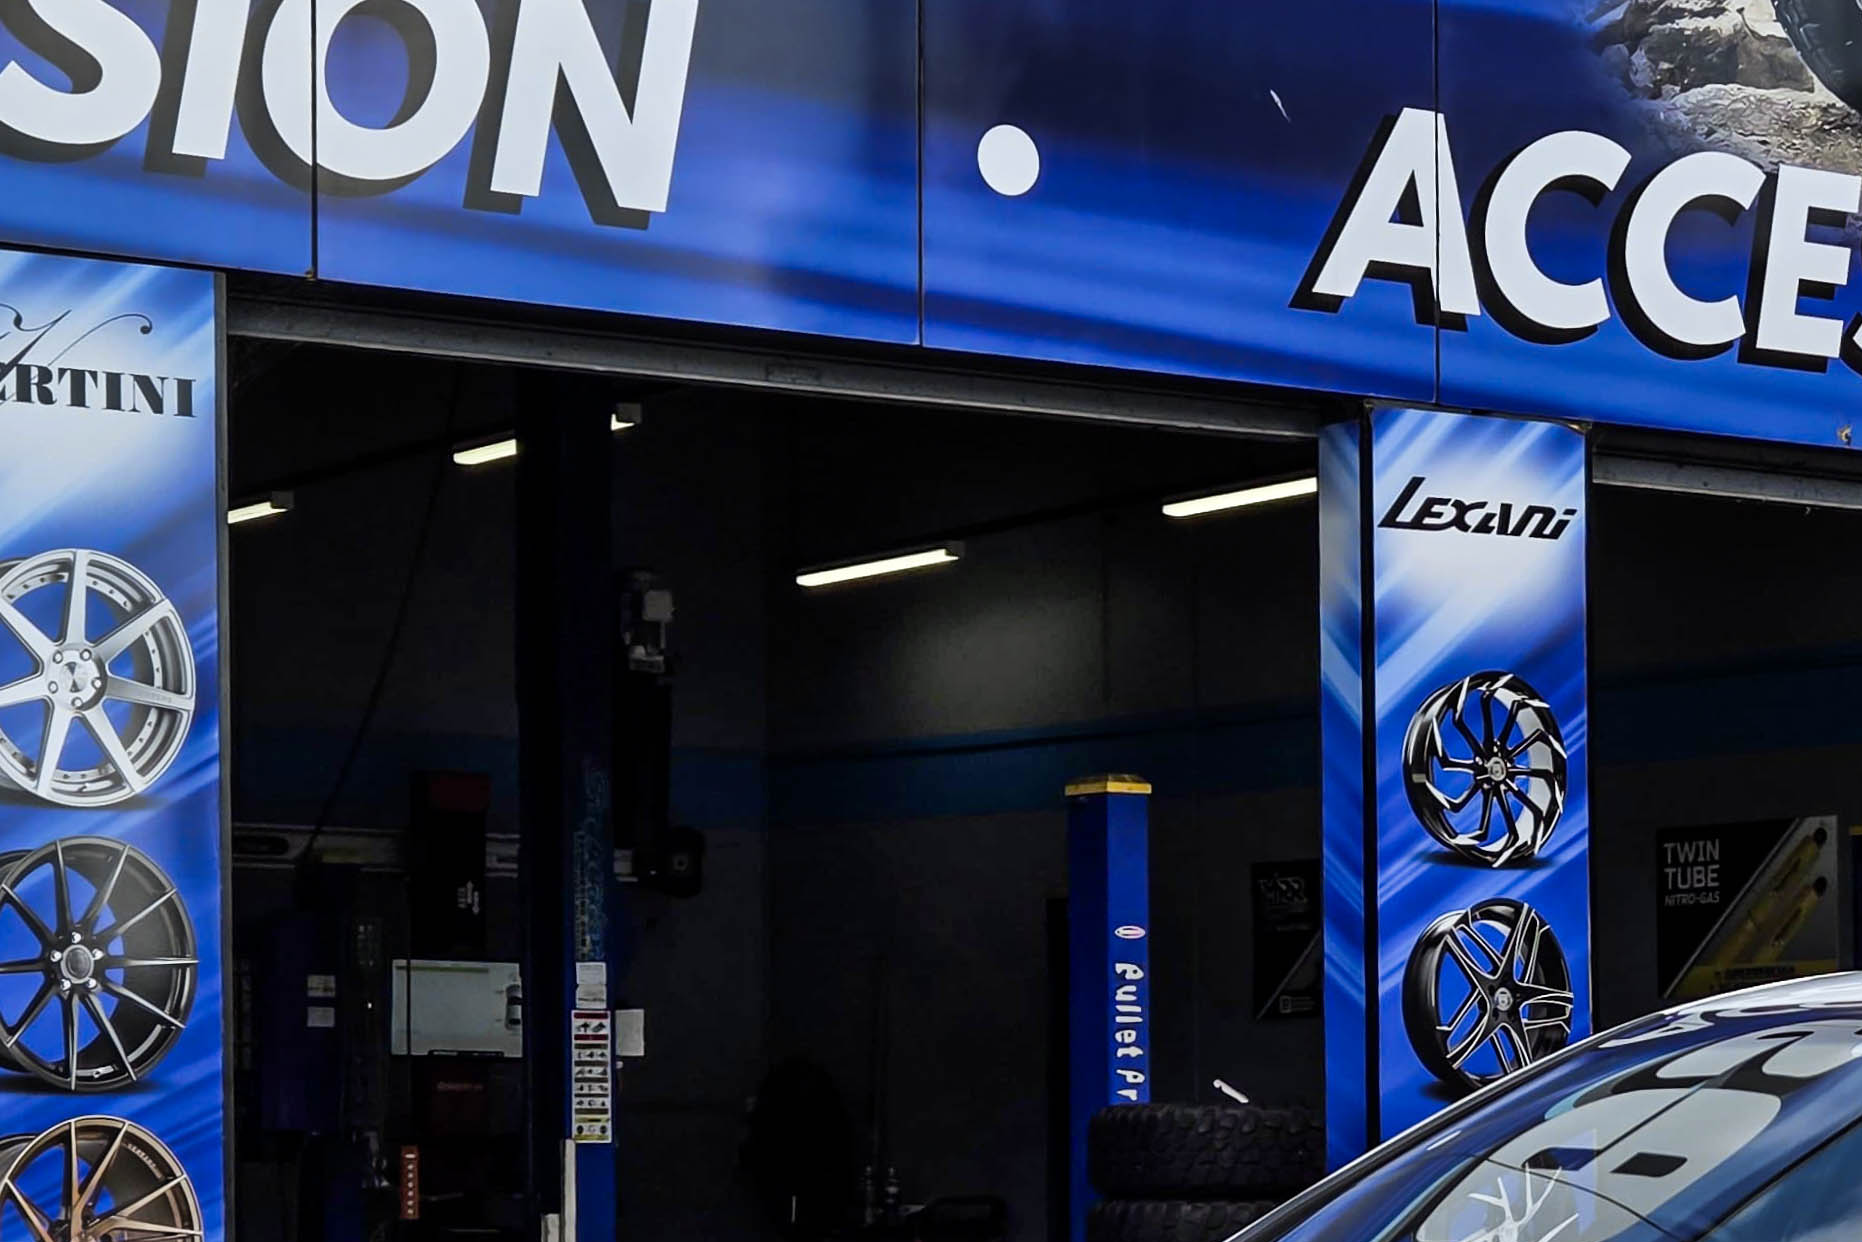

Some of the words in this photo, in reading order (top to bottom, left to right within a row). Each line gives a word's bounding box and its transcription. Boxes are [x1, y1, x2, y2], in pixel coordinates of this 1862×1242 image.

[1663, 839, 1719, 864] TWIN
[1663, 865, 1720, 890] TUBE
[1664, 891, 1720, 907] NITRO-GAS
[1115, 1068, 1146, 1102] Pr
